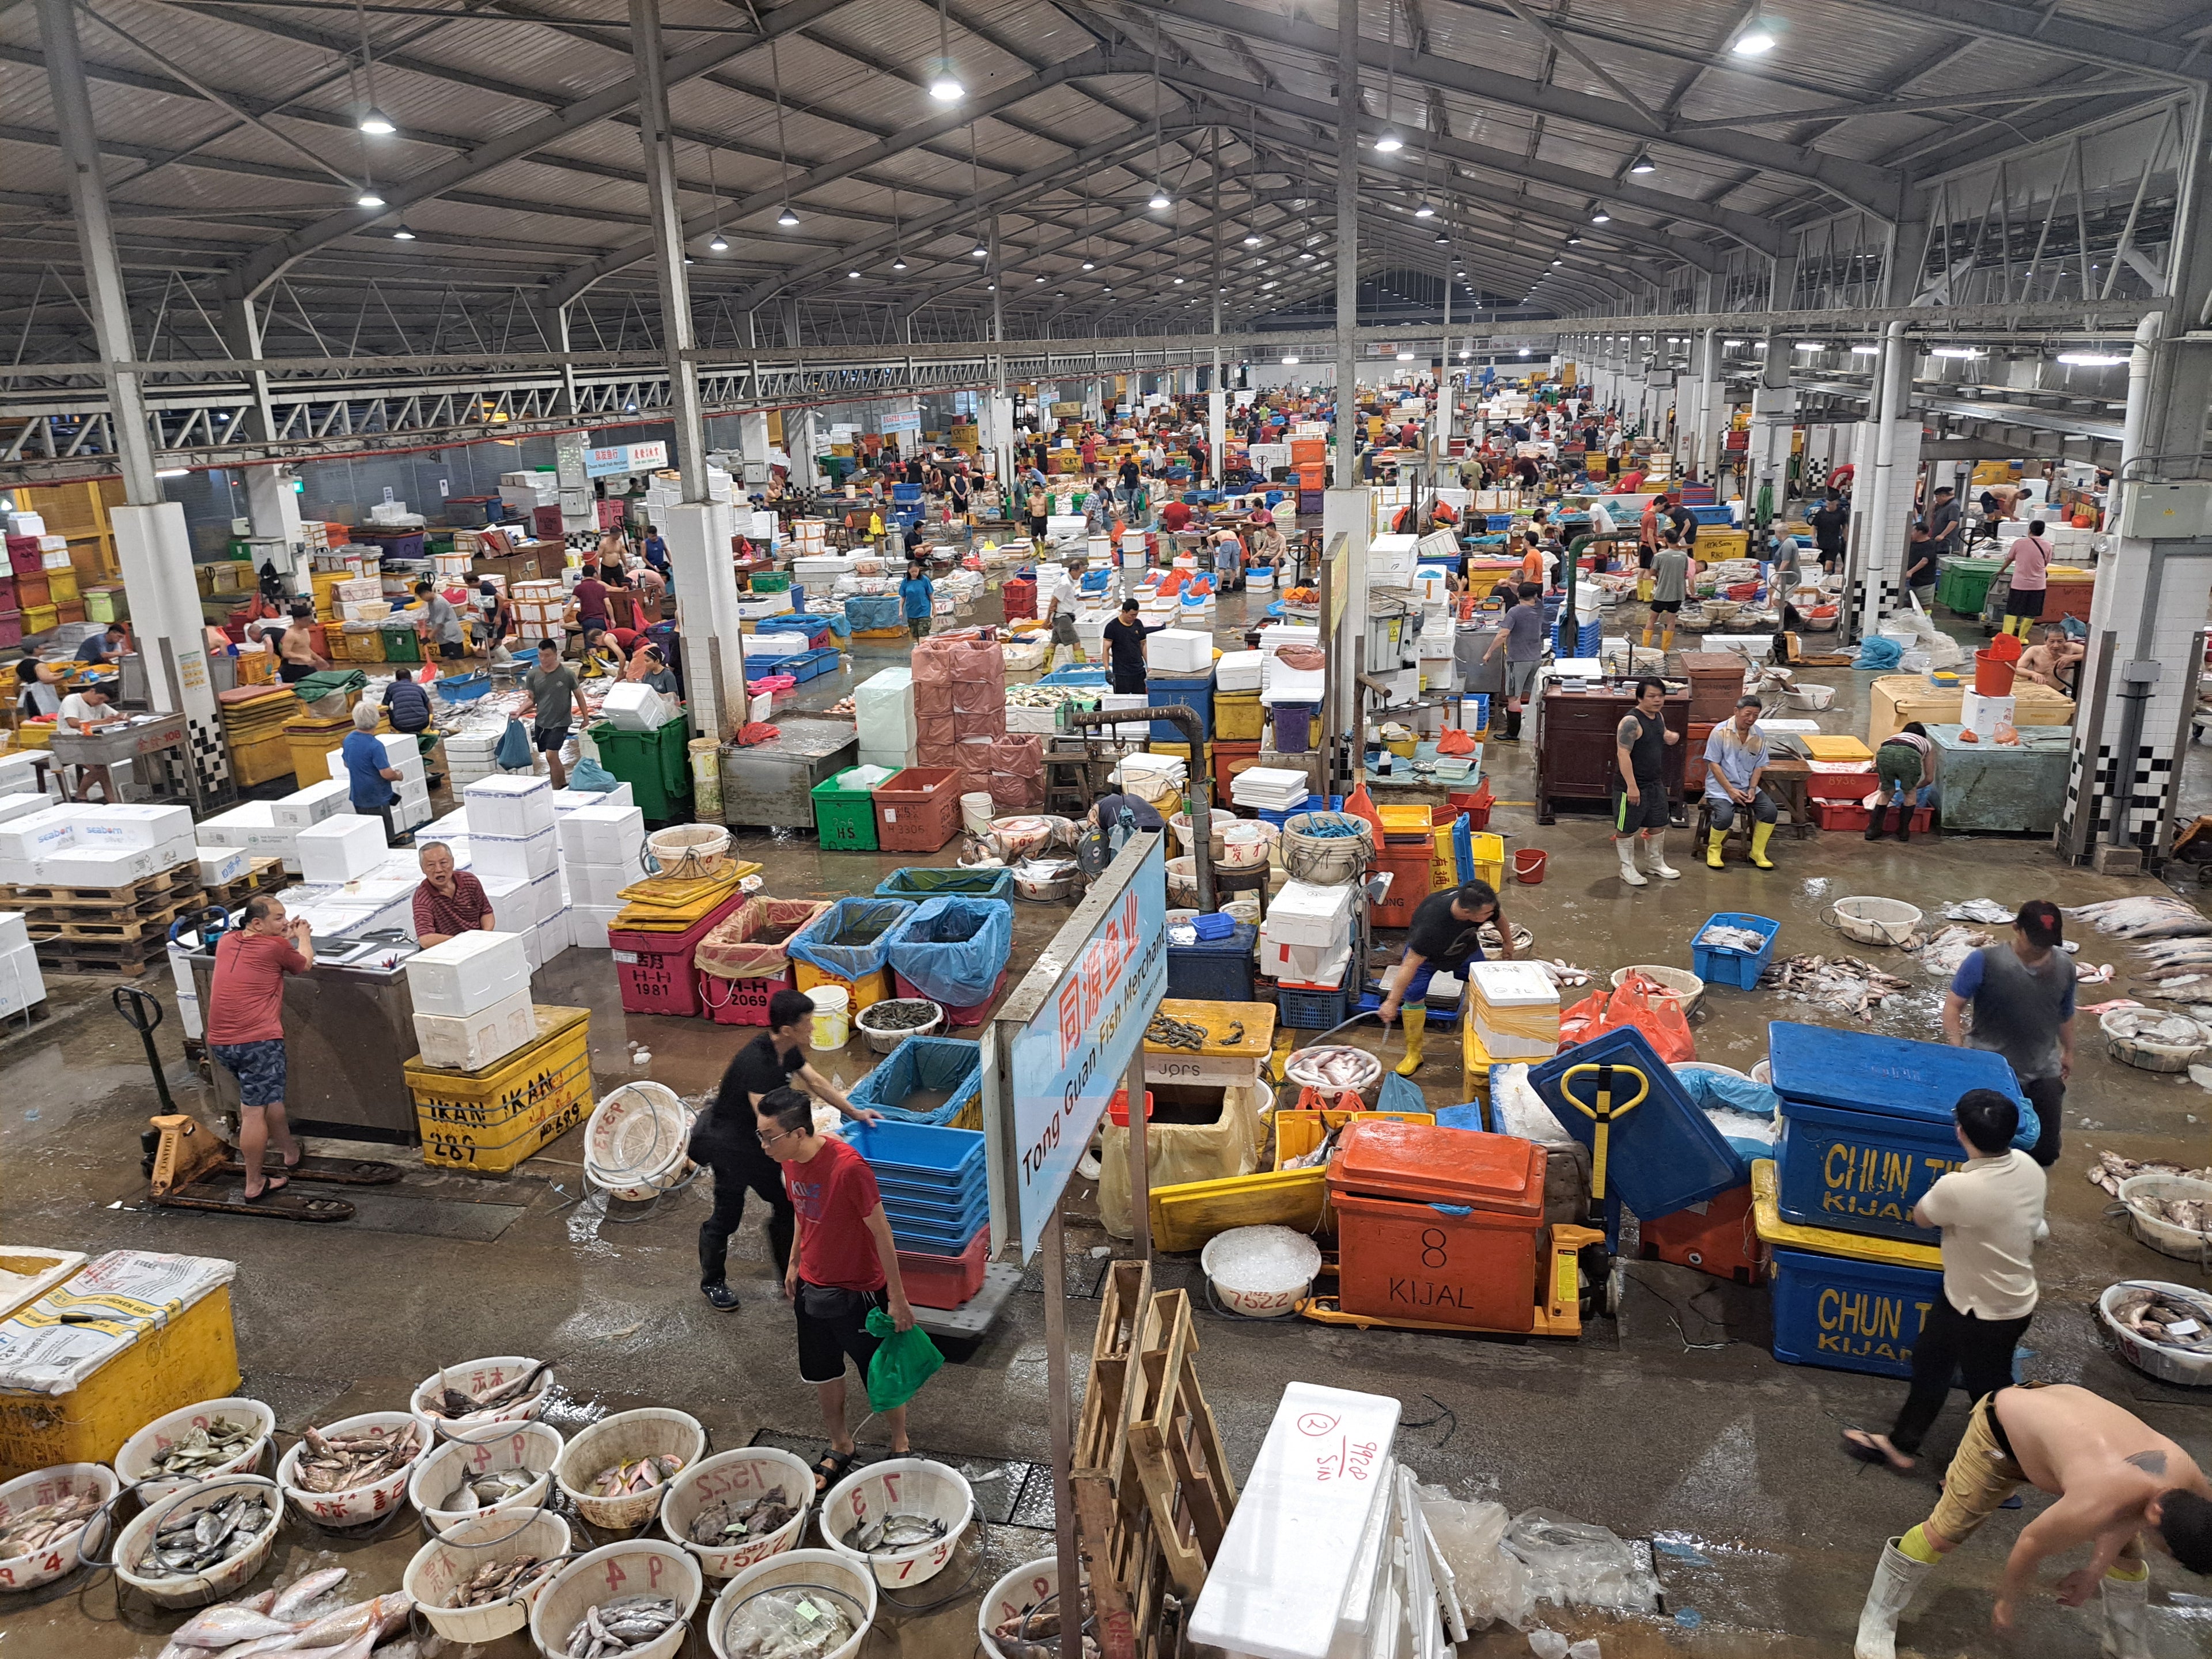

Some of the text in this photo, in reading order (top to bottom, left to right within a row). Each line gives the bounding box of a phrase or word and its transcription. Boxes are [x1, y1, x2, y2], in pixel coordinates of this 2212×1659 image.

[817, 635, 827, 645] AK
[163, 729, 181, 743] 108
[1828, 775, 1857, 786] 8936
[836, 827, 857, 839] HS
[635, 983, 669, 996] 1981
[1058, 889, 1140, 1071] 同源鱼业
[731, 993, 768, 1006] 2069
[1022, 924, 1166, 1187] Tong Guan Fish Merchant
[429, 1097, 487, 1129] IKAN
[161, 1137, 173, 1170] ALLIANCE
[430, 1132, 476, 1163] 289
[1823, 1142, 1914, 1199] CHUN
[1421, 1228, 1448, 1268] 8
[1229, 1290, 1289, 1309] 7522
[1389, 1277, 1475, 1310] KIJAL
[1817, 1287, 1903, 1340] CHUN
[711, 1533, 787, 1571] 7522
